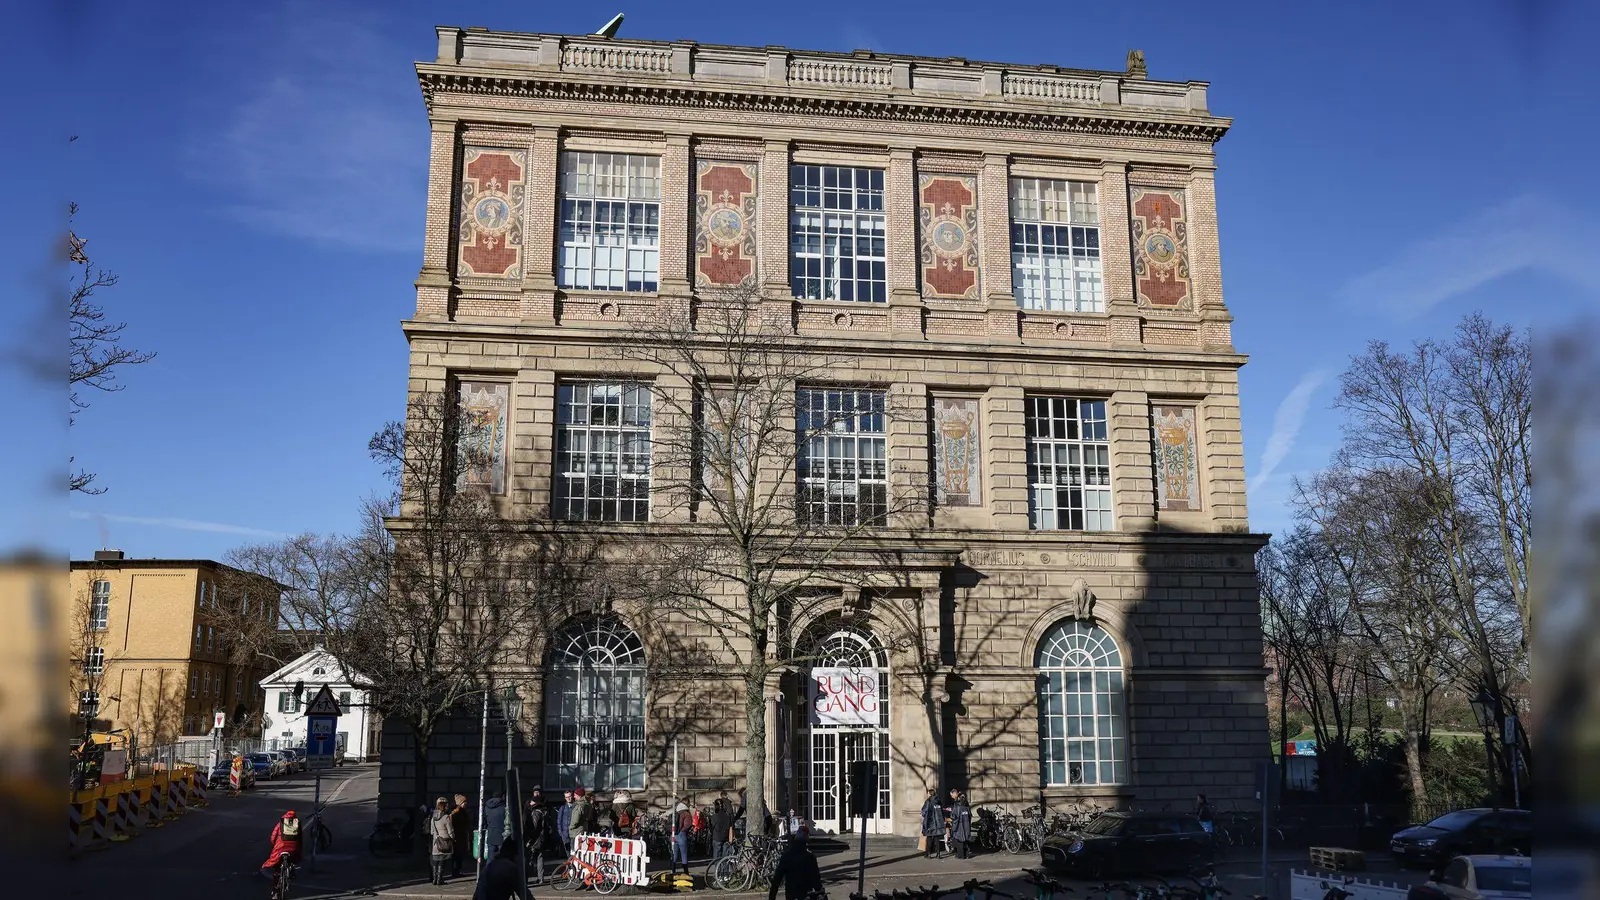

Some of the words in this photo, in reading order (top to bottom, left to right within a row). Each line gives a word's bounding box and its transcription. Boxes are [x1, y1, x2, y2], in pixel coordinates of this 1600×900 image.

[968, 551, 1025, 566] CORNELIUS
[1071, 553, 1116, 567] SCHWIND
[816, 676, 875, 695] RUND
[813, 694, 877, 713] GANG
